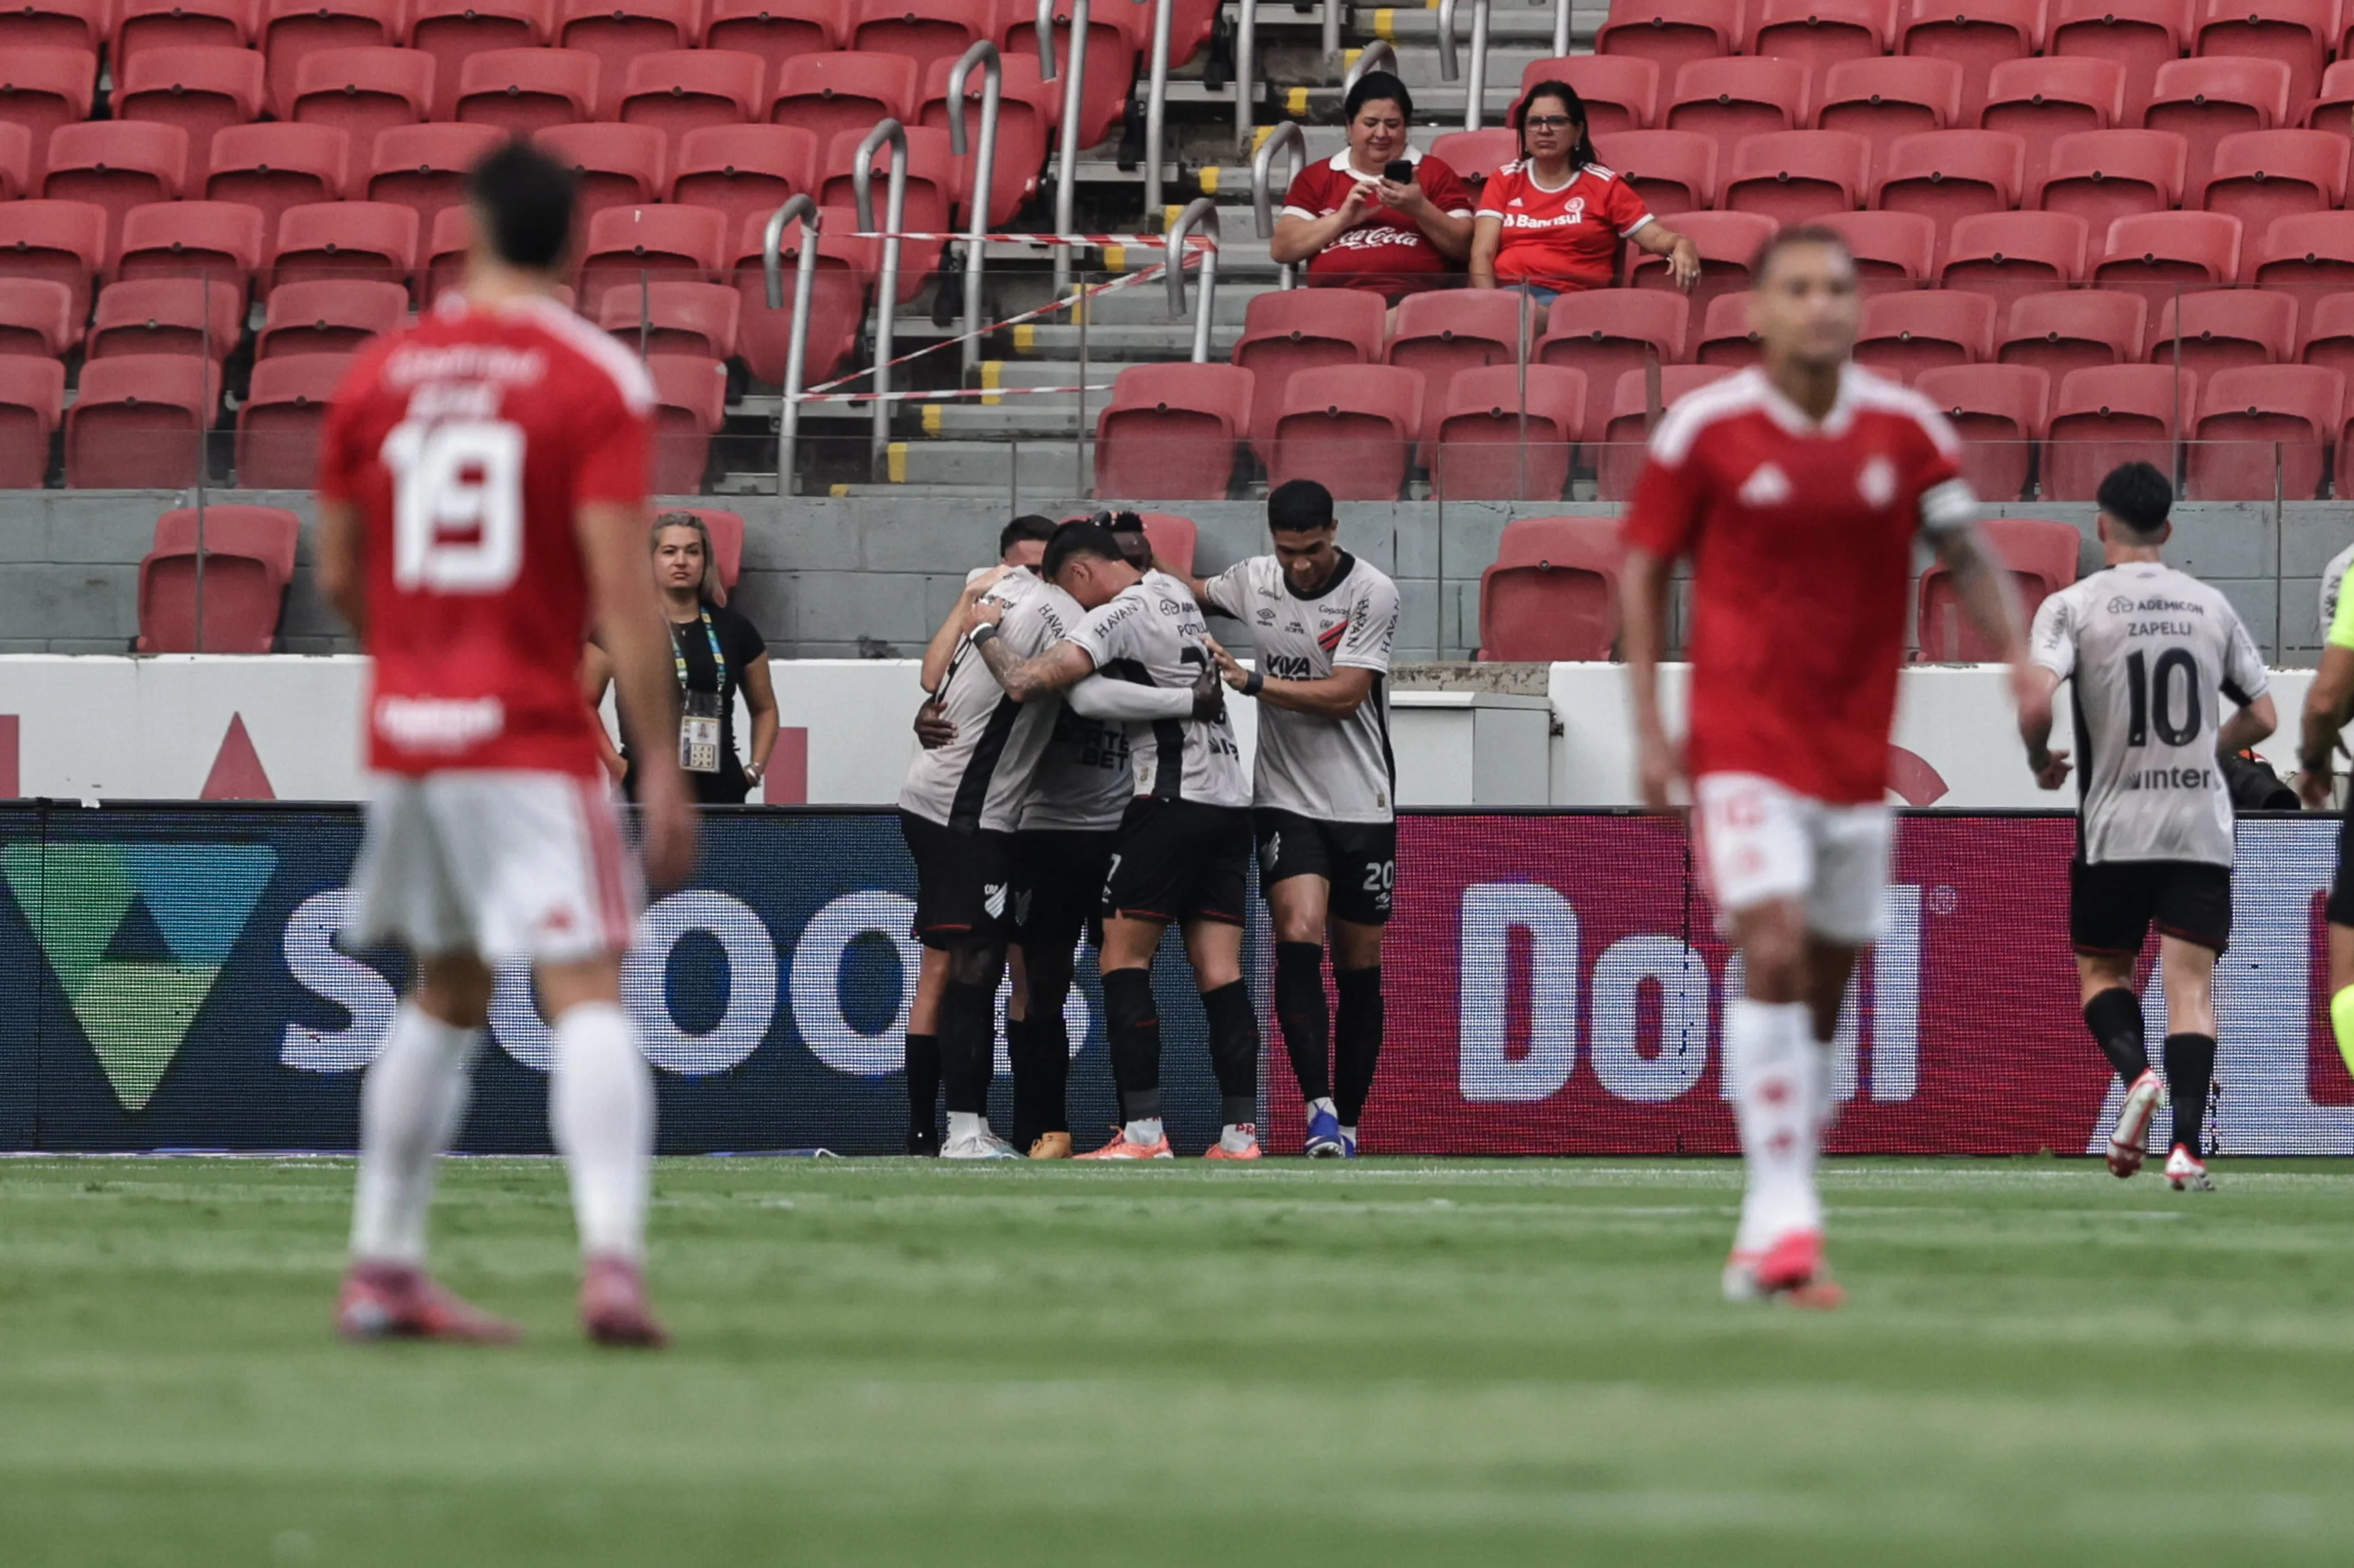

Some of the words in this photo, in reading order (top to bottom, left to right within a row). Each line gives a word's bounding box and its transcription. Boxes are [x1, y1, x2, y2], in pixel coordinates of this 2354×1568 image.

[1094, 603, 1139, 639] HAVAN
[1381, 597, 1400, 654] HAVAN
[2128, 622, 2193, 637] ZAPELLI
[1267, 654, 1311, 676] VIVA
[2125, 647, 2202, 748] 10
[1362, 860, 1395, 891] 20
